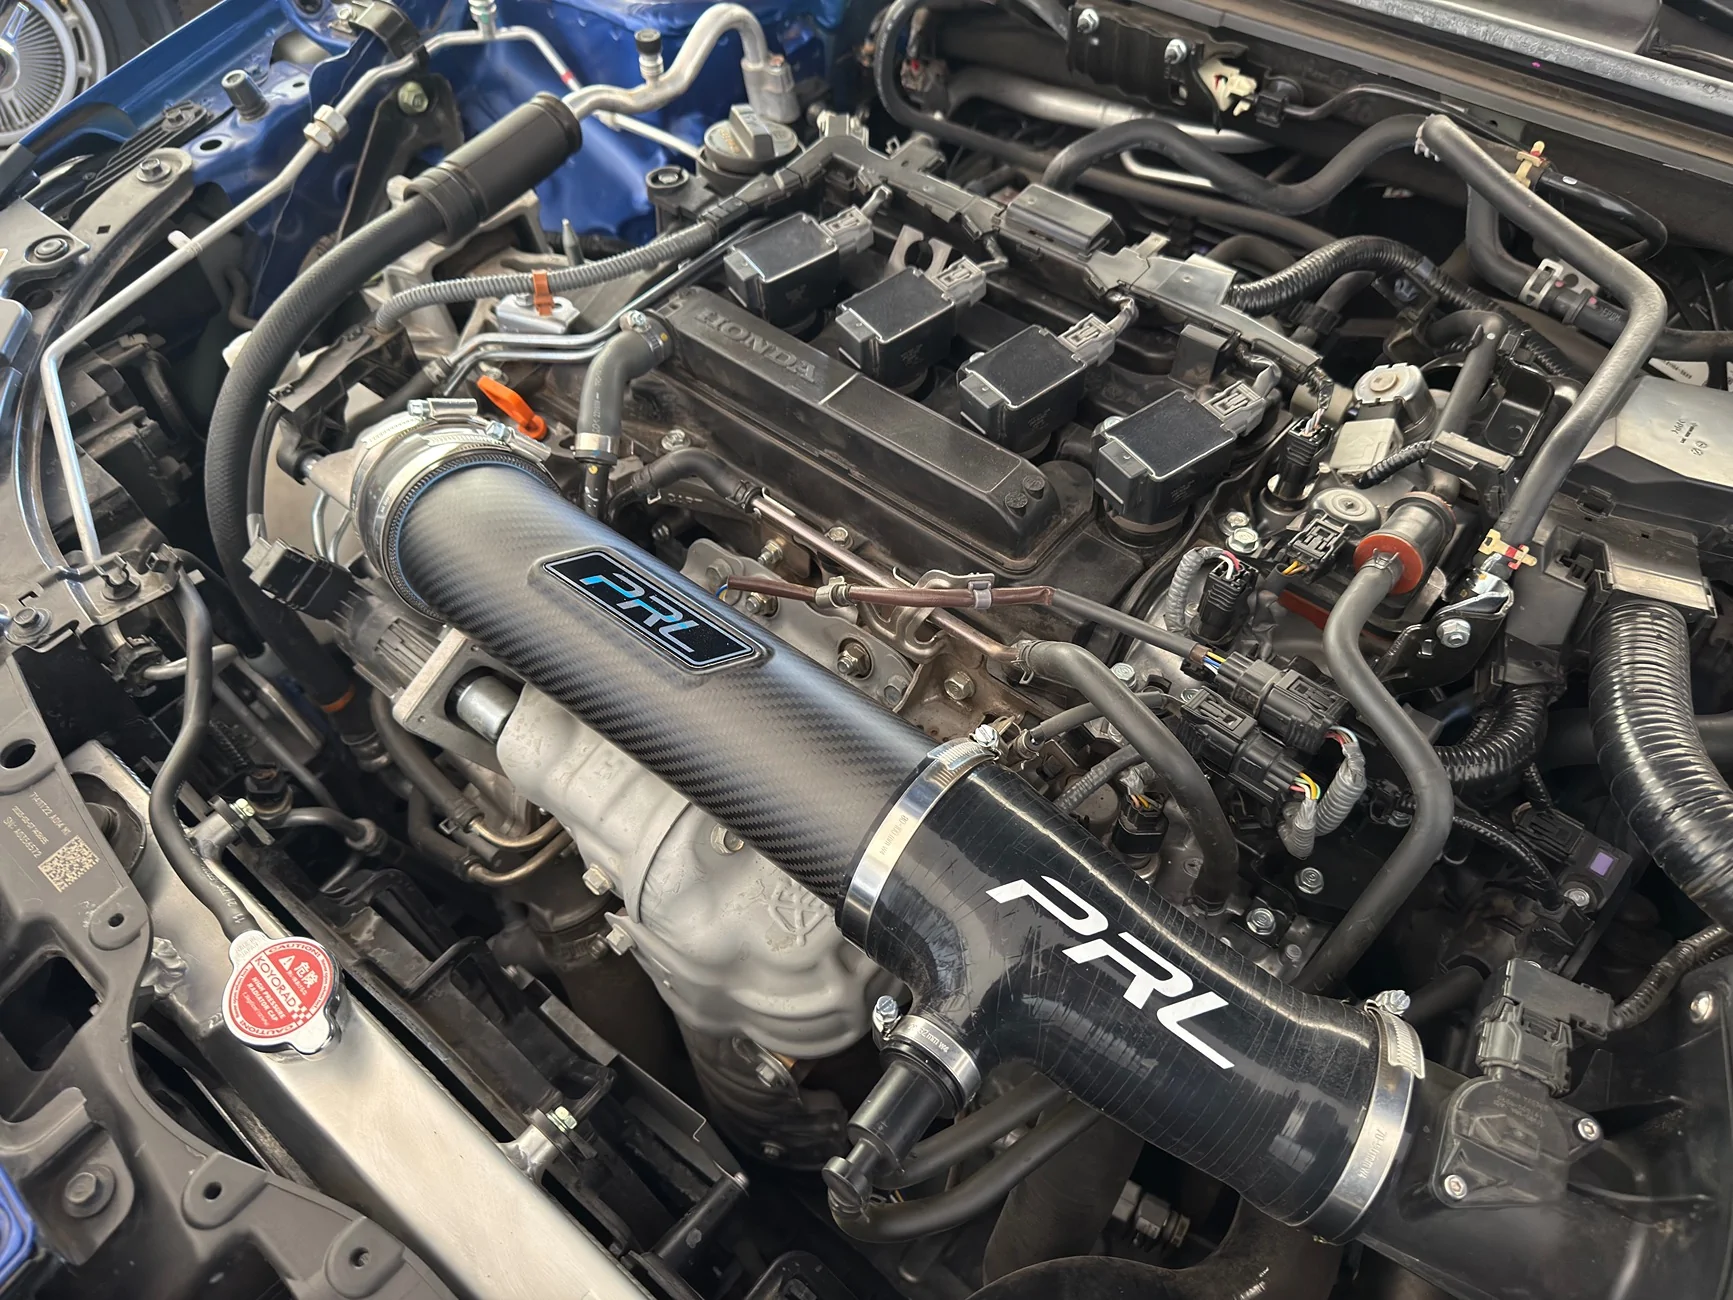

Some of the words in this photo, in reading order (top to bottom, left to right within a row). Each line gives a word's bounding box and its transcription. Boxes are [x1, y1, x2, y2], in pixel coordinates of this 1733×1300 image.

[697, 307, 816, 381] HONDA
[579, 572, 699, 653] PRL
[268, 944, 320, 957] CAUTION!
[985, 875, 1235, 1069] PRL
[255, 957, 297, 1007] KOYORAD
[294, 962, 318, 988] 危険
[246, 983, 270, 1011] RADIATOR
[266, 1009, 279, 1021] CAP
[251, 976, 266, 992] HIGH
[262, 990, 285, 1019] PRESSURE
[239, 1020, 288, 1036] CAUTION!
